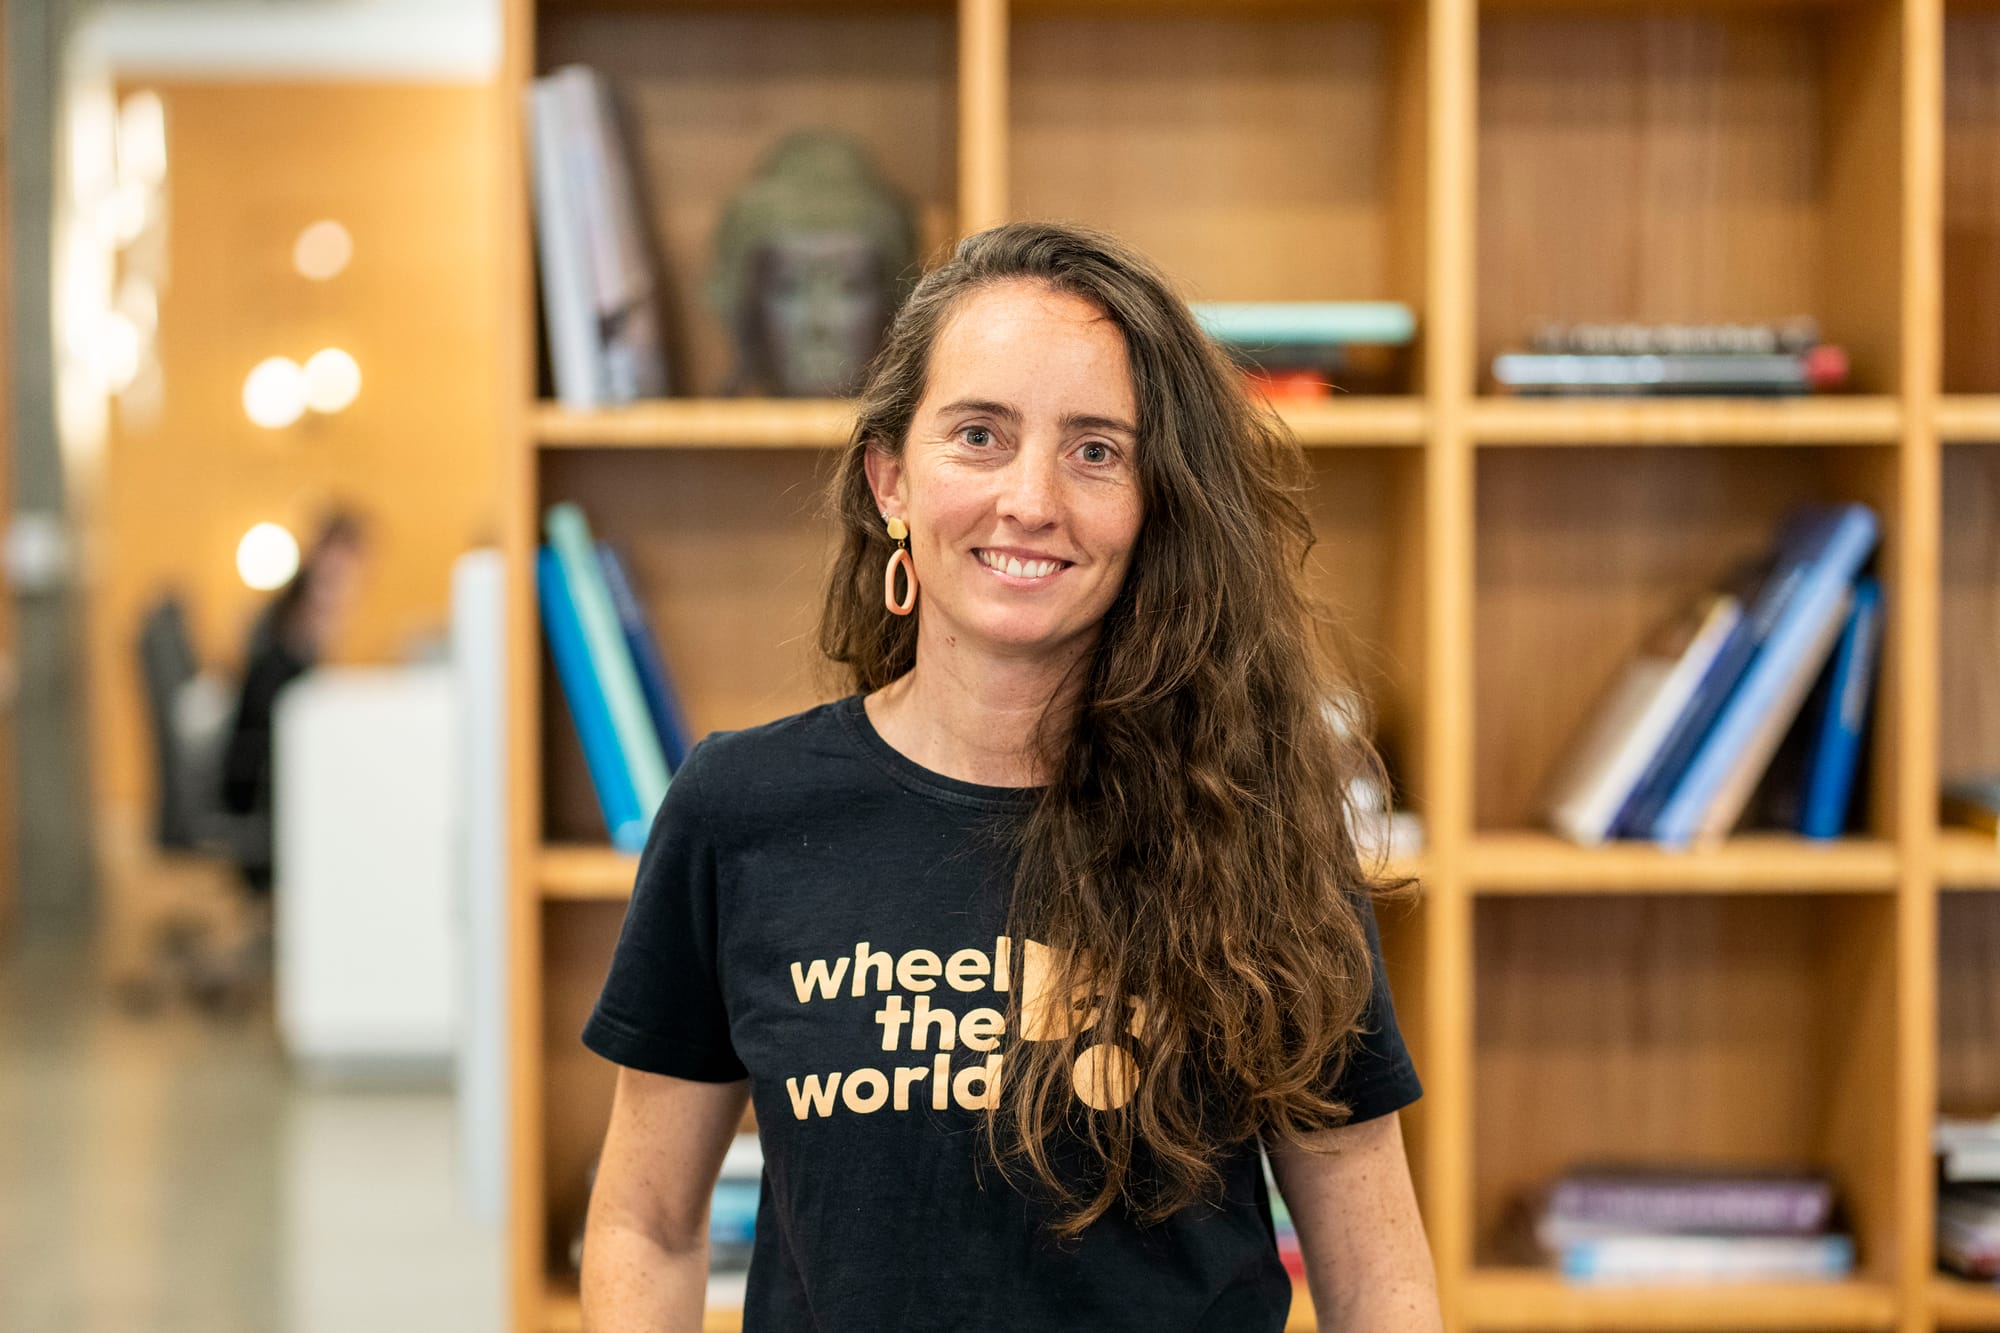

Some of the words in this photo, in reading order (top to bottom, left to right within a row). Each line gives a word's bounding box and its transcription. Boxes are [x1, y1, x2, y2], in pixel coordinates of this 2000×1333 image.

[790, 936, 1011, 1003] wheel
[875, 995, 1006, 1051] the
[786, 1053, 1003, 1120] world
